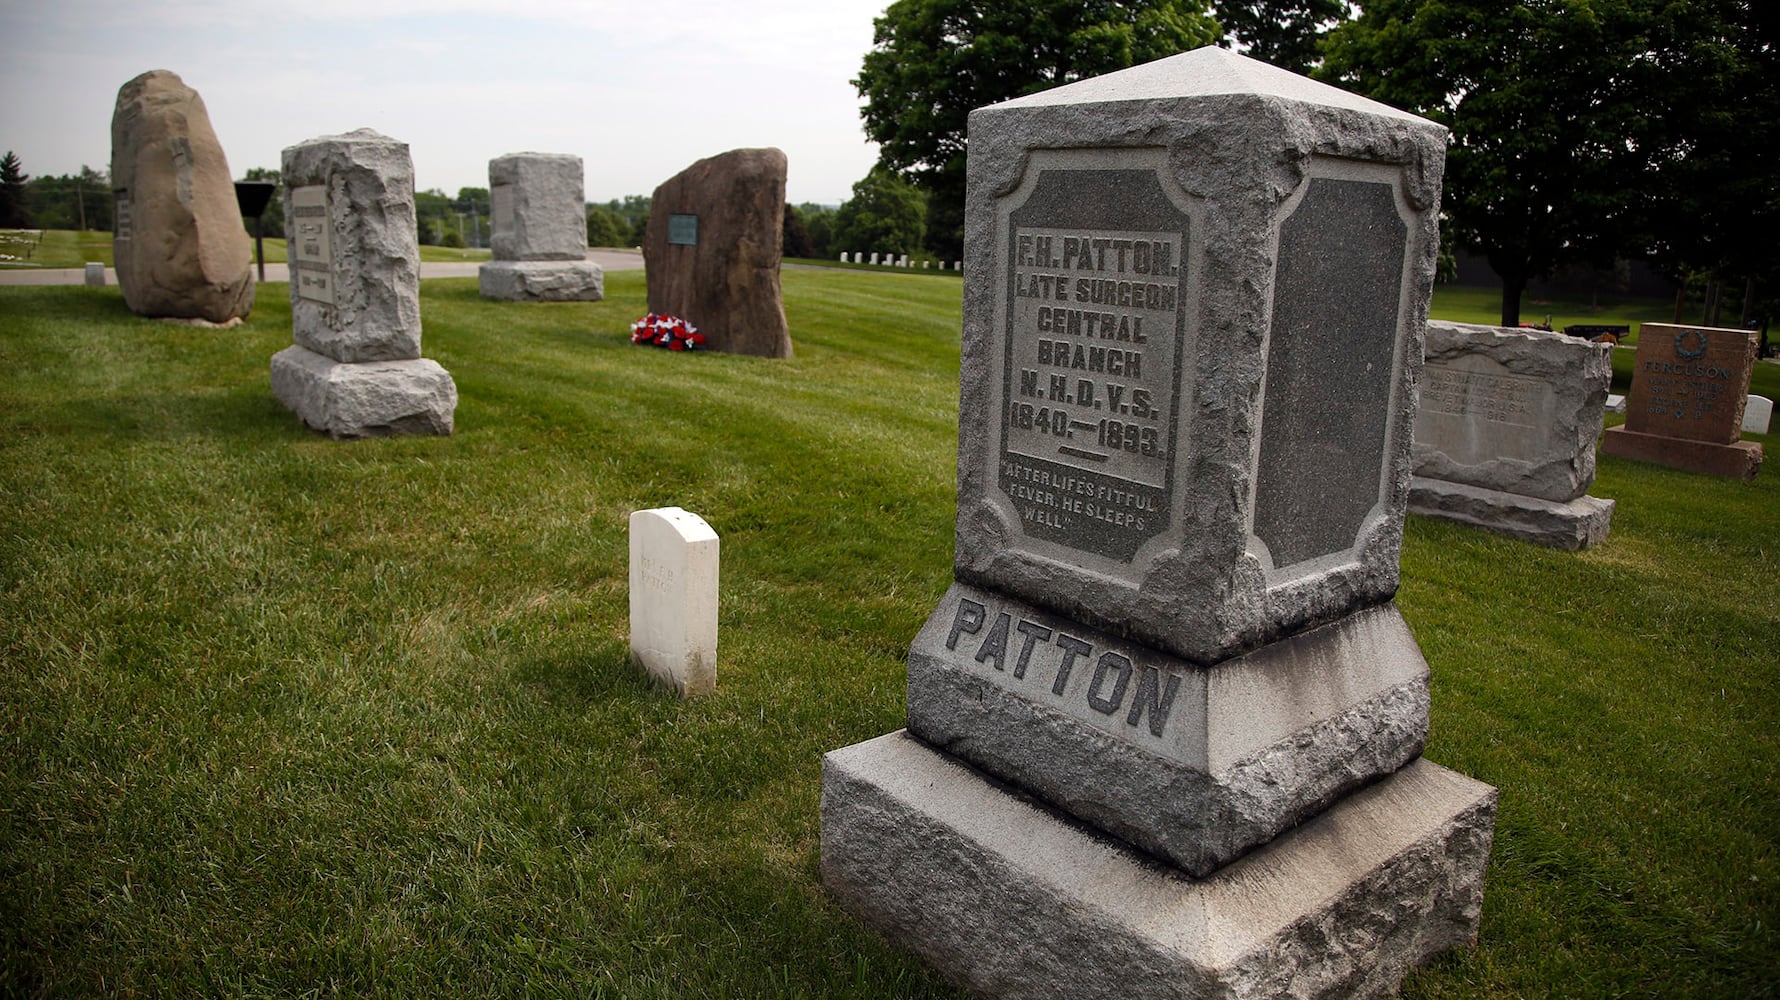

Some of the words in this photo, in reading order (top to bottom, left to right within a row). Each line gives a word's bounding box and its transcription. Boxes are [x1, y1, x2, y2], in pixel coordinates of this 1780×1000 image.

[1063, 235, 1178, 277] PATTON.
[1016, 272, 1069, 301] LATE
[1076, 277, 1178, 311] SURGEON
[1037, 305, 1147, 344] CENTRAL
[1037, 337, 1142, 379] BRANCH
[1644, 361, 1729, 380] FERGUSON
[1062, 496, 1082, 513] HE
[1086, 503, 1145, 531] SLEEPS
[946, 598, 1183, 738] PATTON
